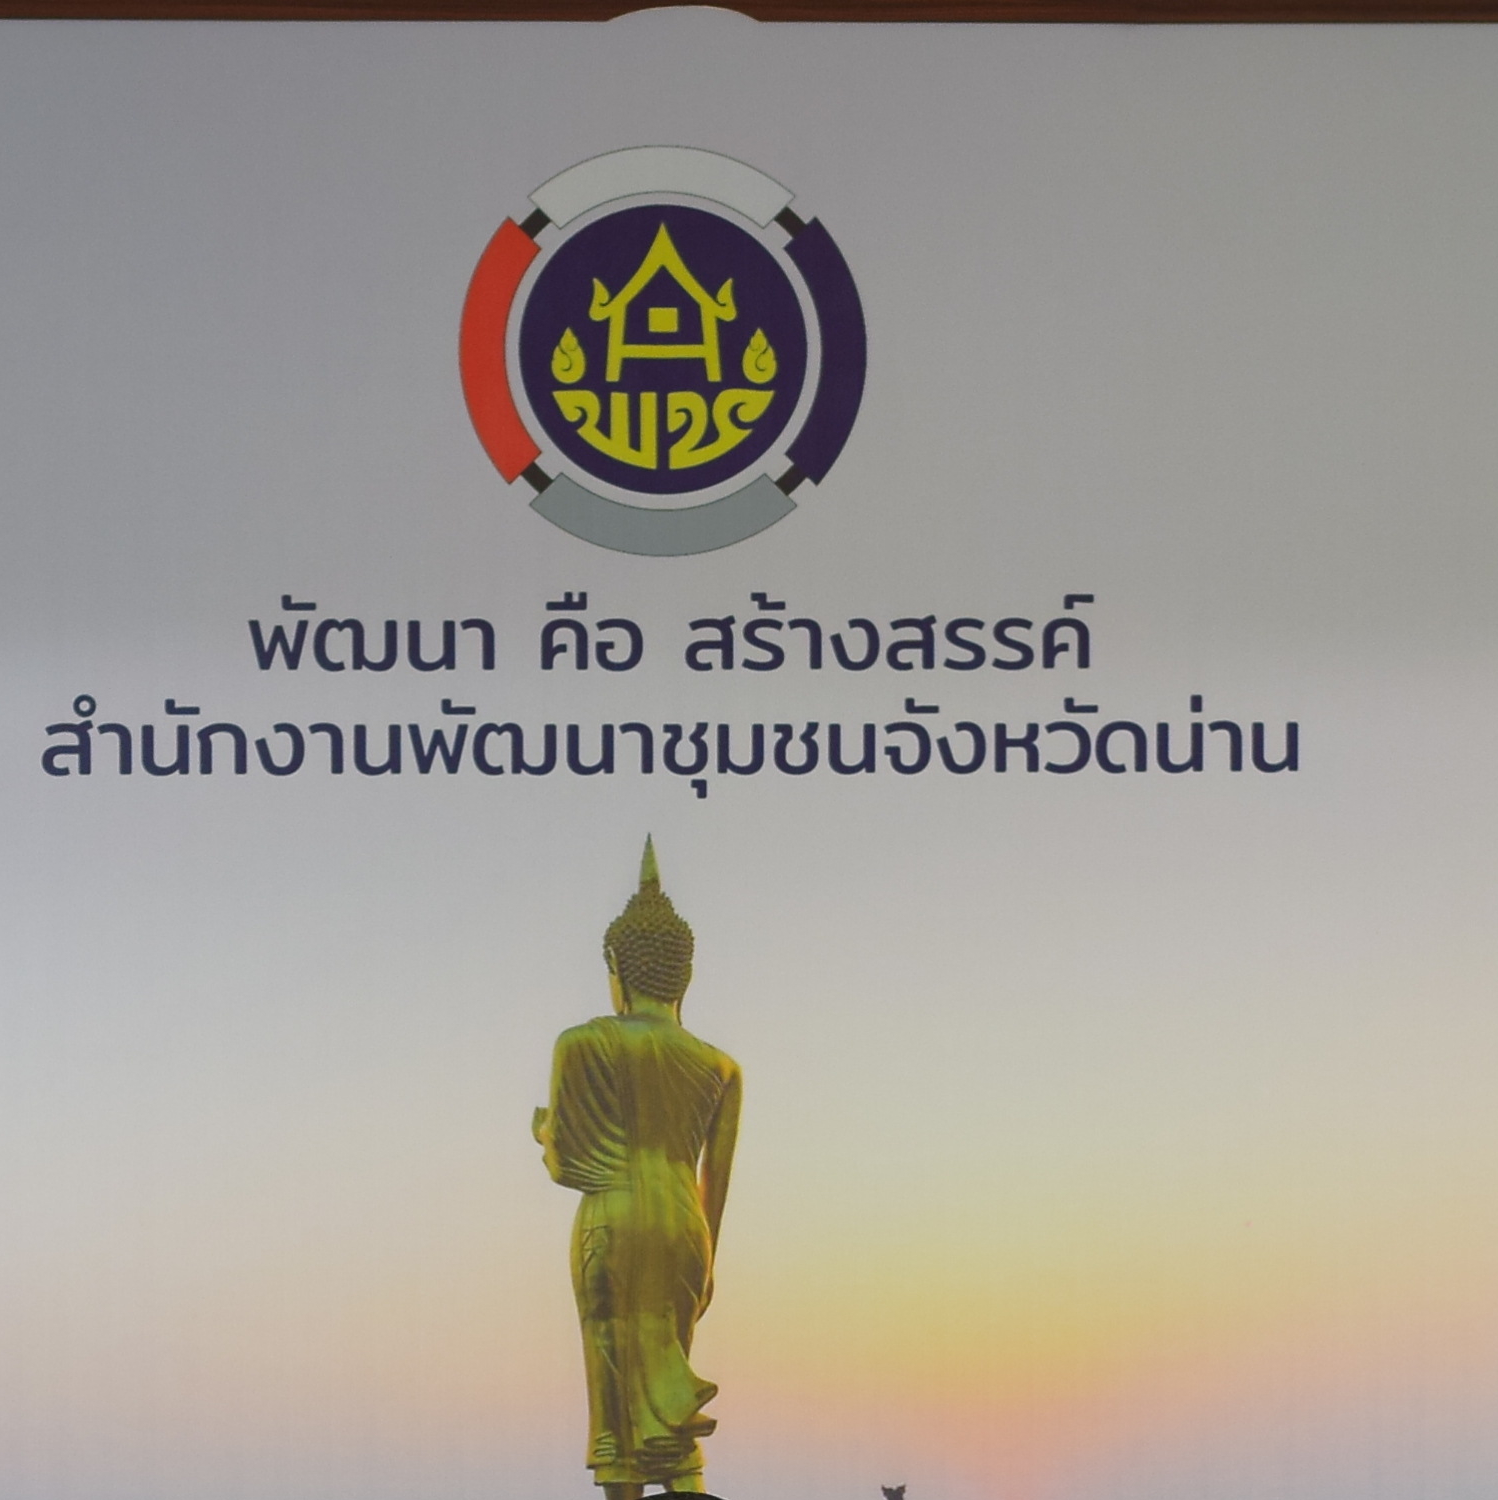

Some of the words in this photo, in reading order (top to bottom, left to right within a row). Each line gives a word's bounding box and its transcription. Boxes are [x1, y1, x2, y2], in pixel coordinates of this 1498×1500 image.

[248, 591, 496, 672] พัฒนา
[540, 591, 644, 672] คือ
[685, 590, 1096, 672] สร้างสรรค์
[41, 693, 1299, 799] สำนักงานพัฒนาชุมชนจังหวัดน่าน
